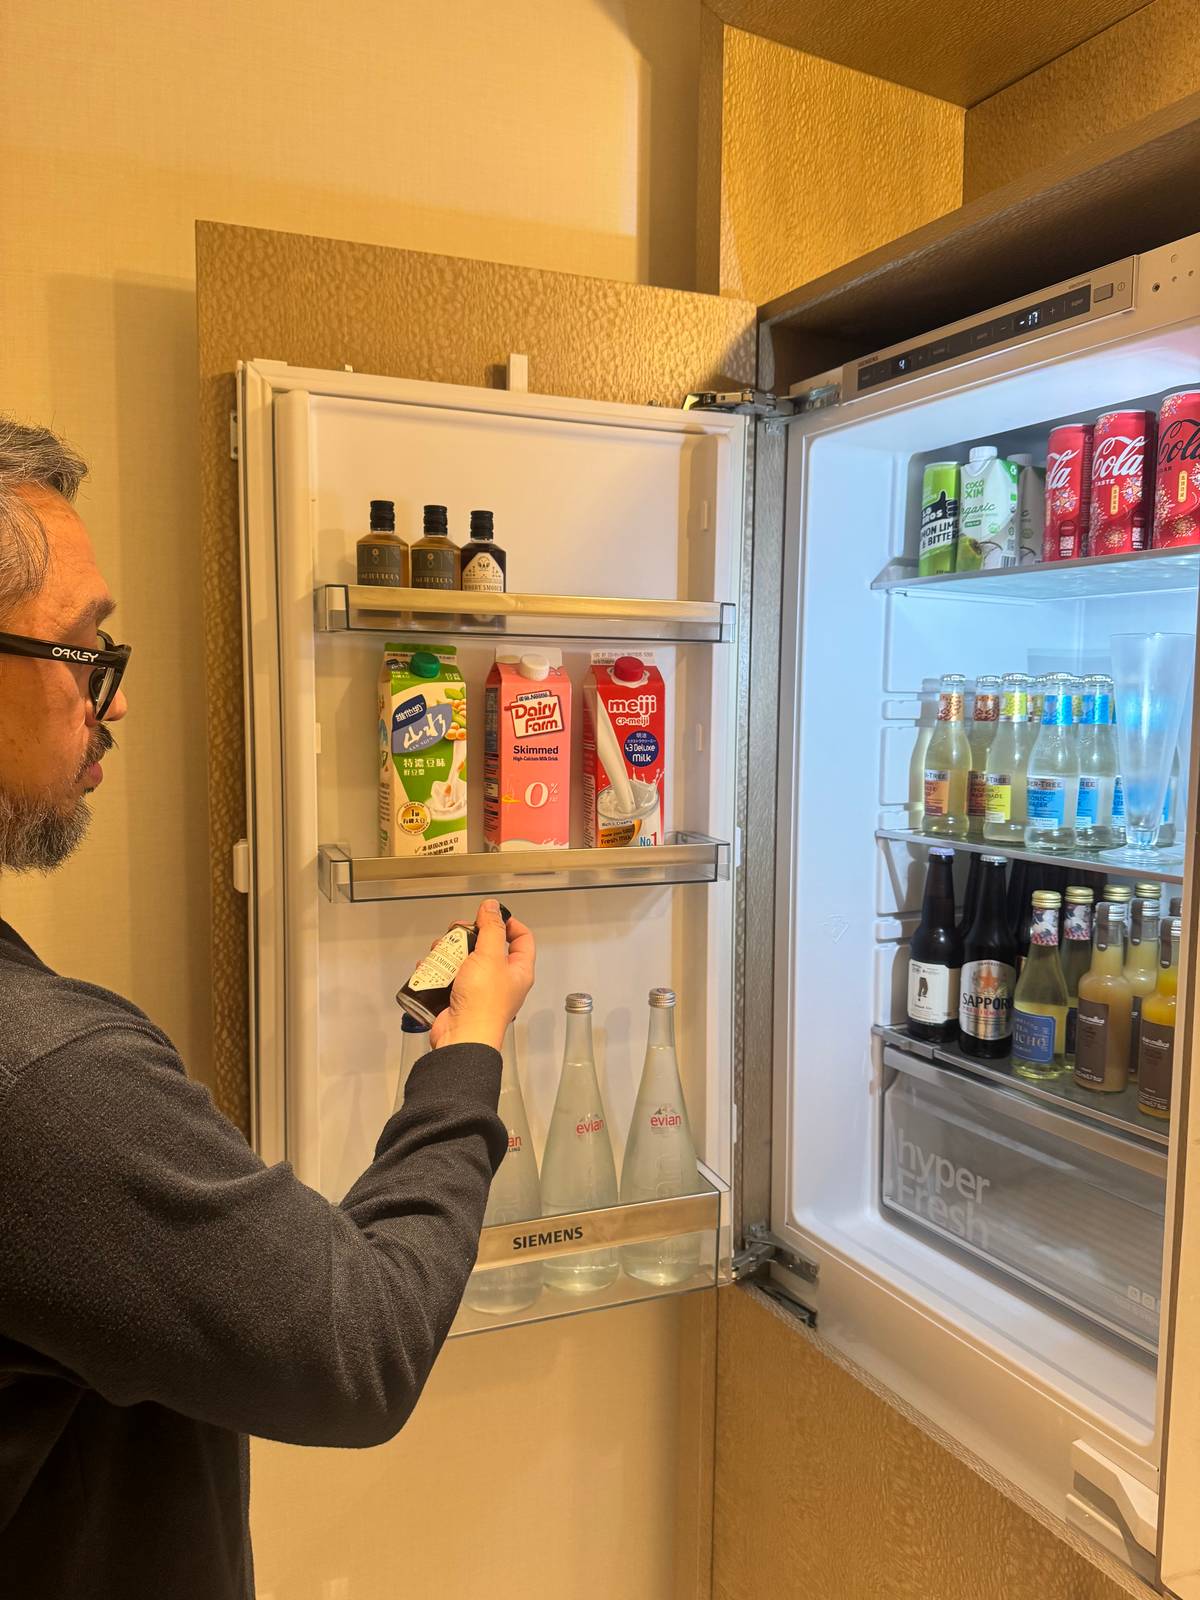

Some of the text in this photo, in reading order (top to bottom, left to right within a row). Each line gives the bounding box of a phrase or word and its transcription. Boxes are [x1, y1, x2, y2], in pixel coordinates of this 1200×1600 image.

[1092, 436, 1146, 481] Cola
[965, 480, 984, 490] COCO
[965, 488, 984, 499] XIM
[51, 646, 99, 662] OAKLEY
[508, 702, 557, 719] Dairy
[608, 695, 657, 717] meiji
[525, 718, 558, 733] Farm
[616, 716, 649, 727] CP-meiji
[513, 745, 559, 755] Skimmed
[634, 743, 656, 752] Deluxe
[632, 753, 652, 762] Milk
[575, 1118, 604, 1136] evian
[651, 1112, 681, 1128] evian
[899, 1128, 991, 1205] hyper
[897, 1168, 989, 1249] Fresh
[513, 1226, 584, 1250] SIEMENS
